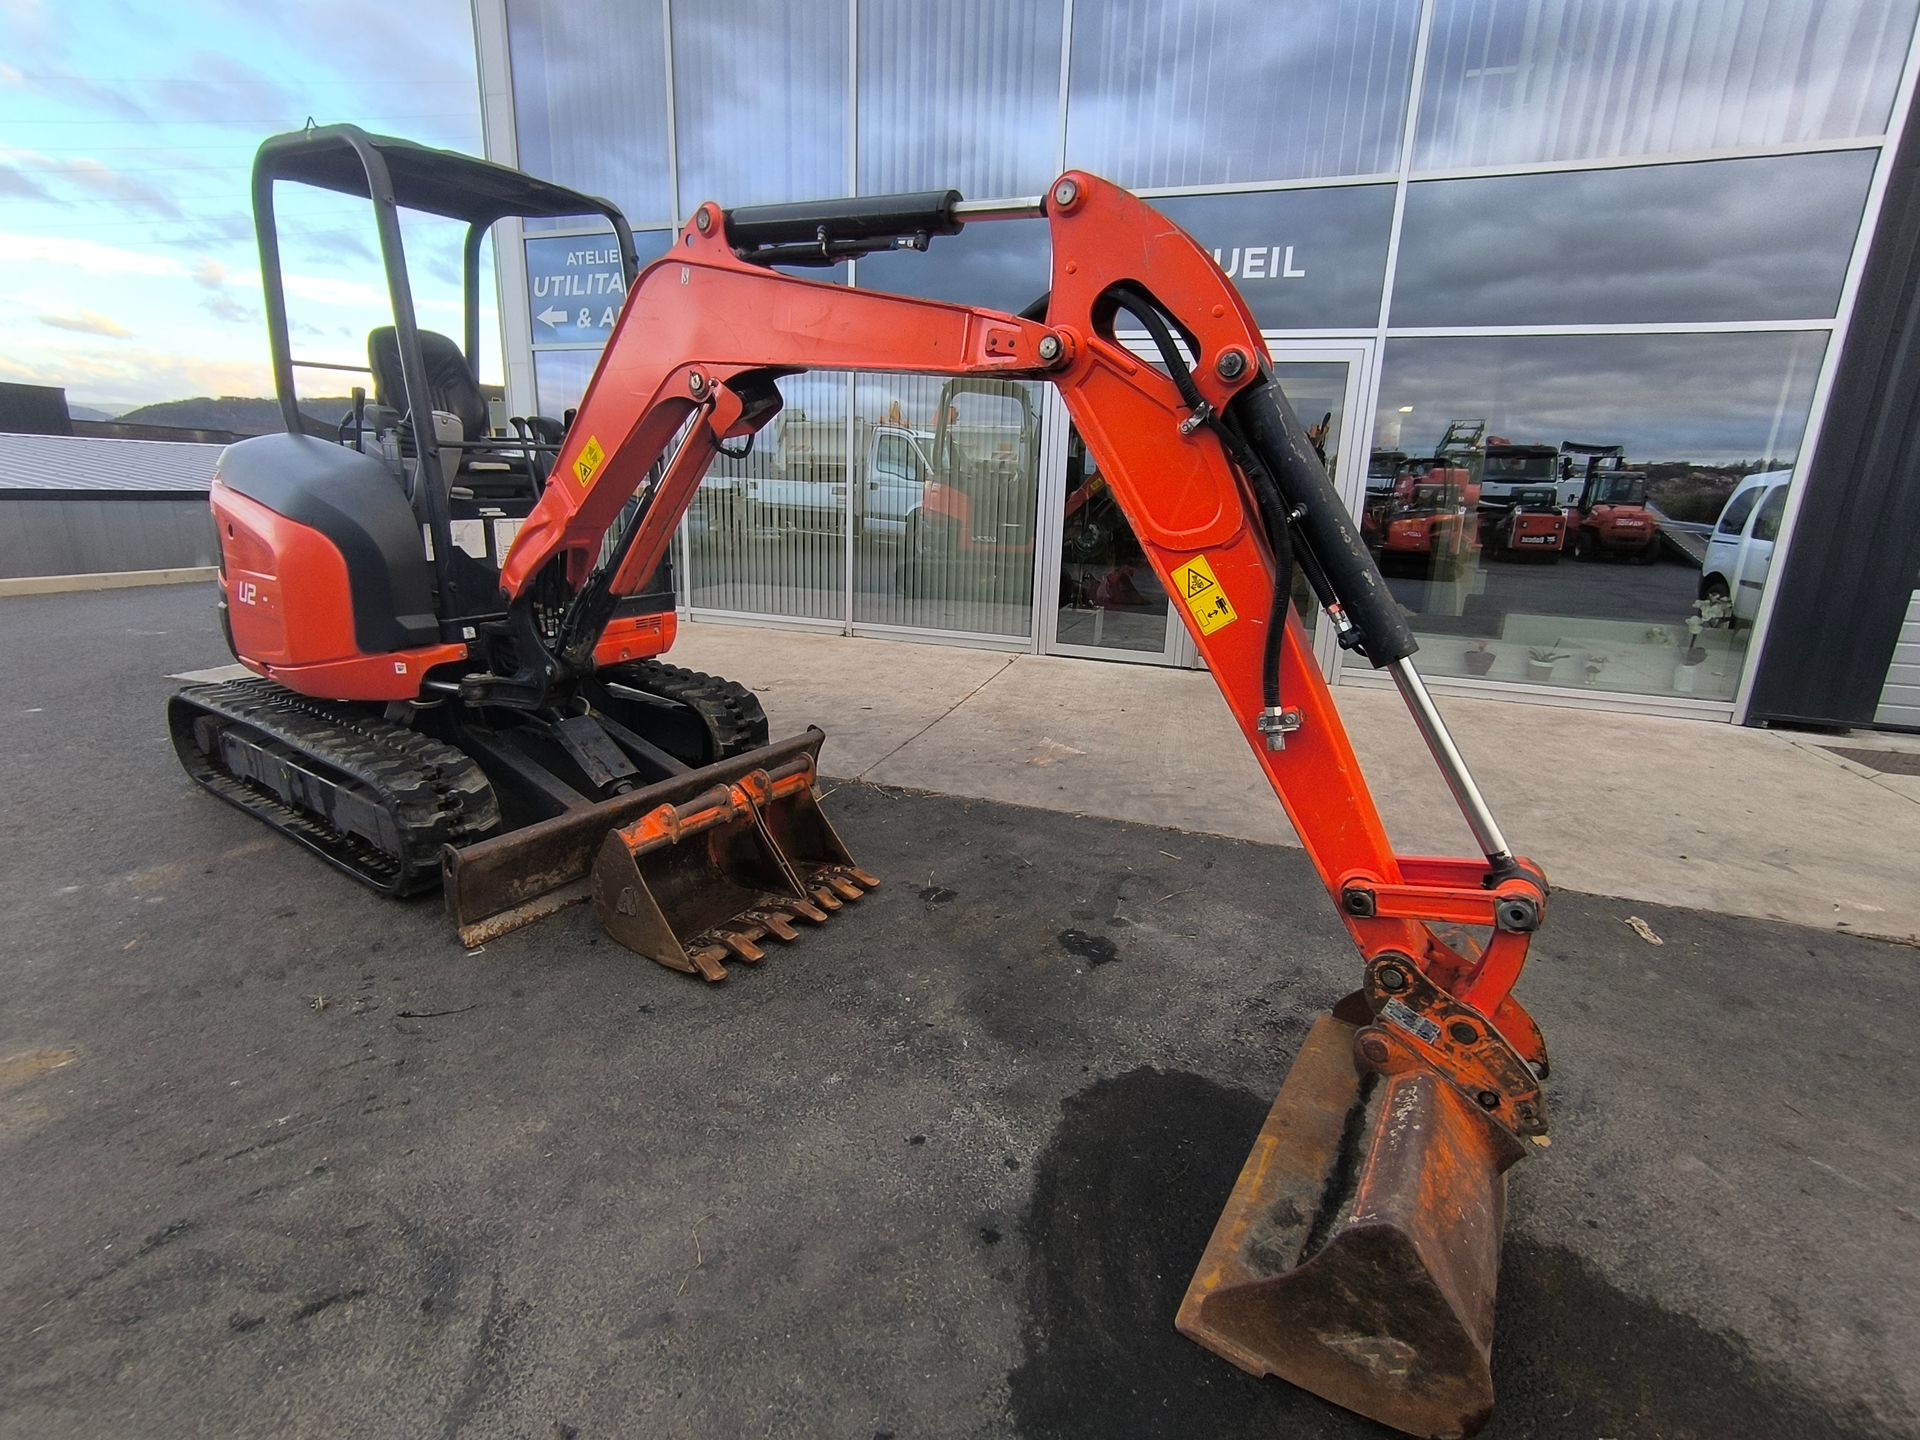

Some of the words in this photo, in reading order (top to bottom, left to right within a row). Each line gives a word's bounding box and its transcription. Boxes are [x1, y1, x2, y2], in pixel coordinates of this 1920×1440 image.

[566, 249, 619, 267] ATELIE
[1213, 245, 1306, 279] UEIL
[533, 272, 624, 298] UTILITA
[576, 307, 592, 329] &
[599, 306, 623, 328] A
